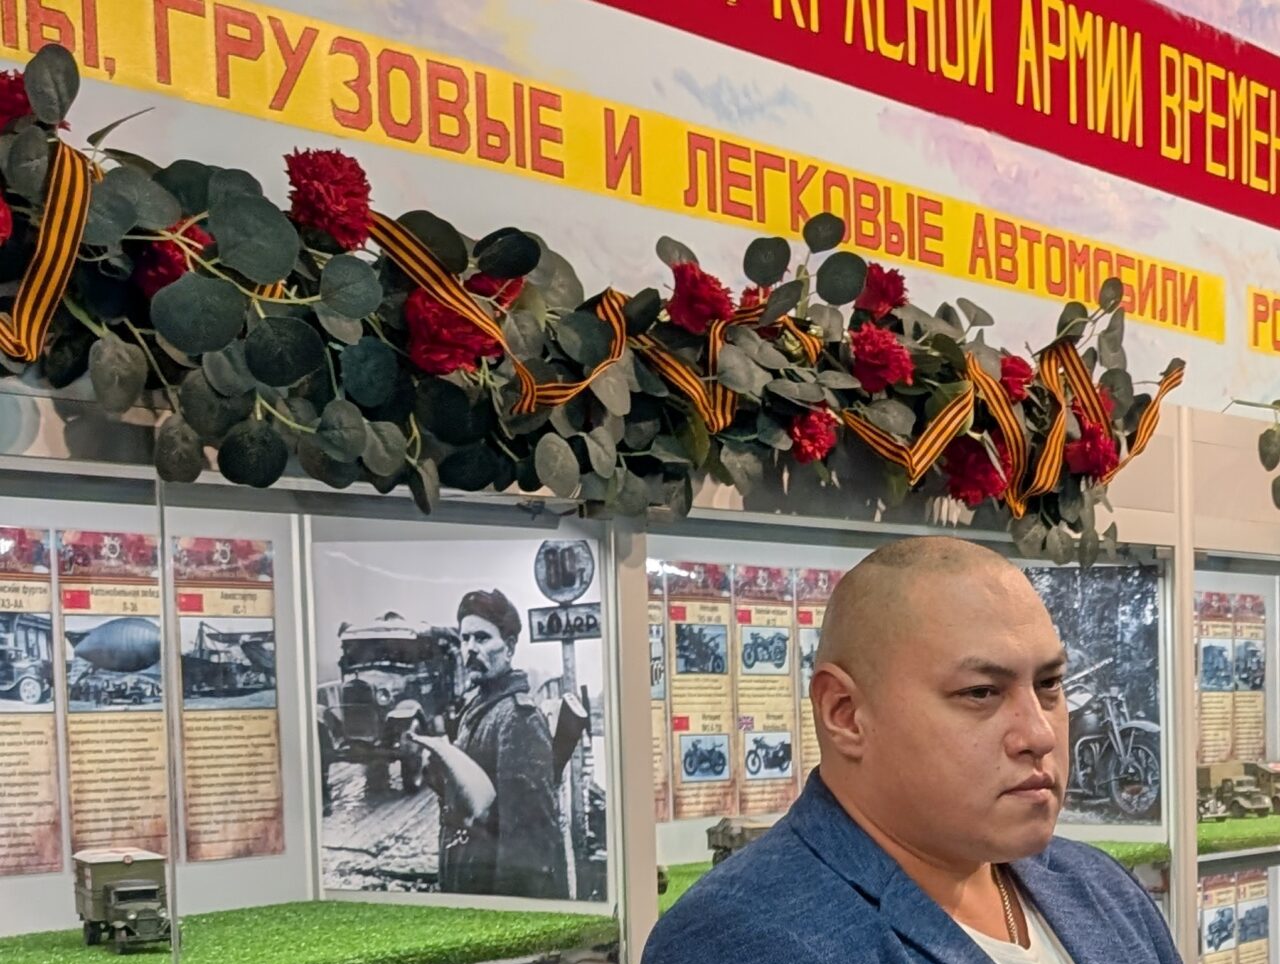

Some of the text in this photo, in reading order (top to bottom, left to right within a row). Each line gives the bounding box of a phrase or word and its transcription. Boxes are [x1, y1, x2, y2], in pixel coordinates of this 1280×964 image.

[154, 0, 565, 179] ГРУЗОВЫЕ
[604, 108, 642, 196] И
[684, 131, 944, 267] ЛЕГКОВЫЕ
[968, 212, 1199, 331] АВТОМОБИЛИ
[1016, 0, 1144, 148] АРМИИ
